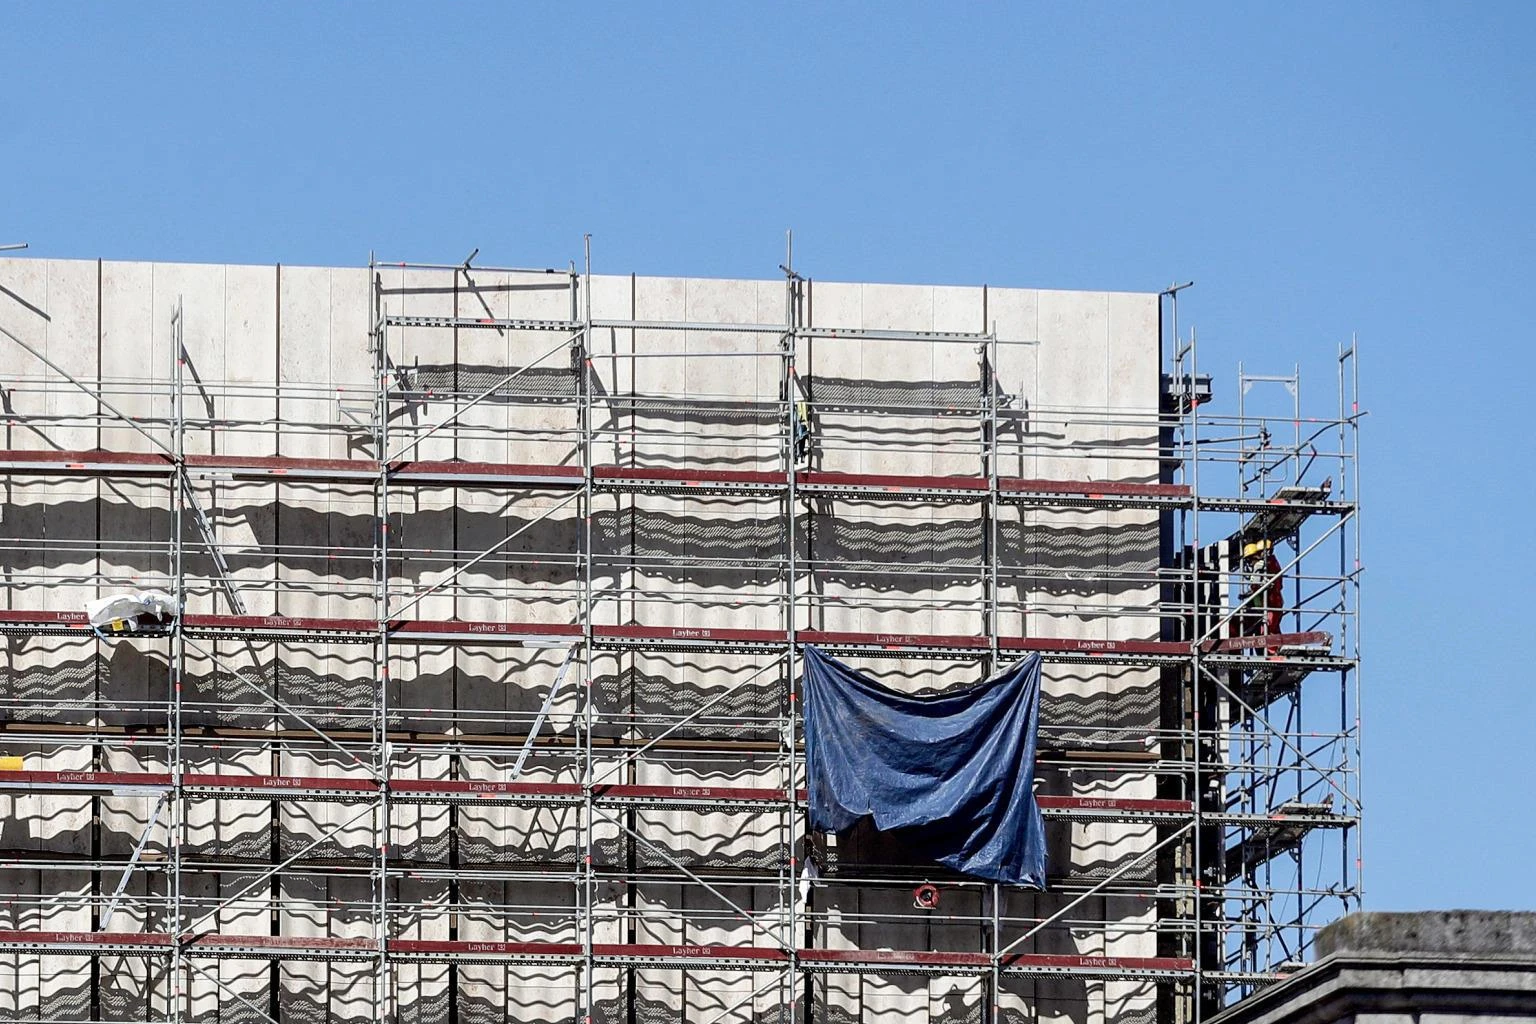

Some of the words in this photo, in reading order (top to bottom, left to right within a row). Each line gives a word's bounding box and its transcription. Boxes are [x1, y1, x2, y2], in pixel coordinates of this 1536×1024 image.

[57, 612, 85, 622] Layher
[468, 623, 496, 633] Layher
[672, 628, 700, 638] Layher
[876, 634, 904, 644] Layher
[1078, 640, 1106, 650] Layher
[56, 772, 84, 782] Layher
[263, 778, 291, 787] Layher
[469, 783, 497, 792] Layher
[1079, 798, 1107, 808] Layher
[56, 933, 84, 943] Layher
[468, 943, 496, 952] Layher
[672, 946, 700, 956] Layher
[1079, 957, 1107, 967] Layher
